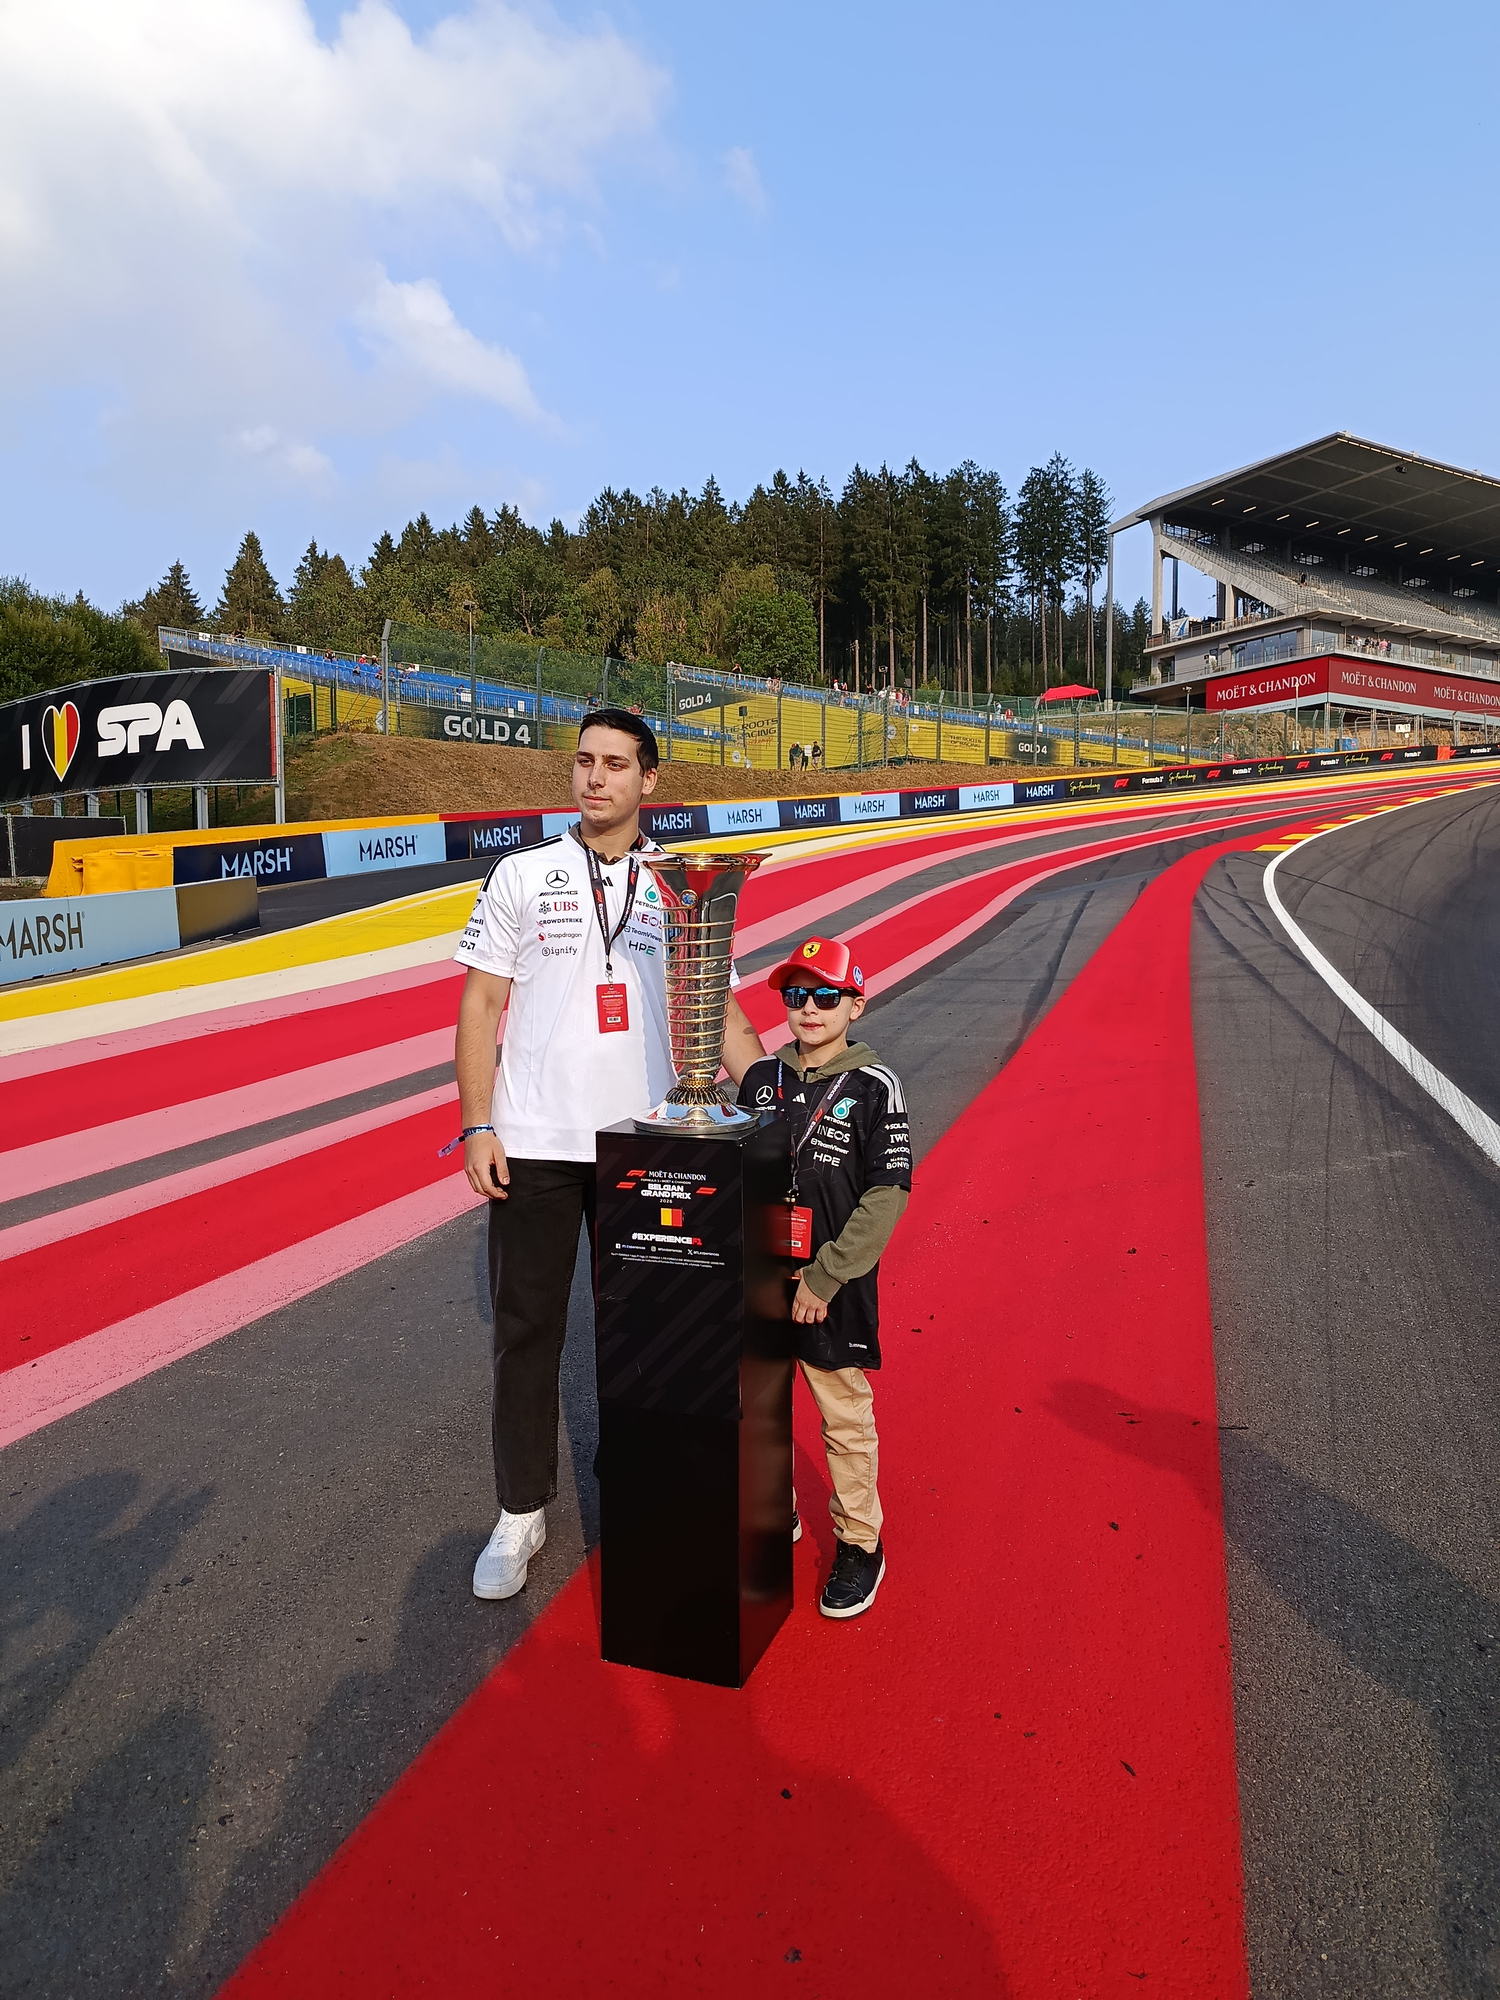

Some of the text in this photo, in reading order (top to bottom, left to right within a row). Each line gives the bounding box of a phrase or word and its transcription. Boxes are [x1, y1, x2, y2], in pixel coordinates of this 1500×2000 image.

[1216, 672, 1317, 702] MOËT & CHANDON
[1341, 671, 1416, 694] MOËT & CHANDON
[678, 692, 711, 711] GOLD 4
[1433, 685, 1456, 700] MOËT
[1457, 690, 1464, 702] &
[21, 699, 205, 770] I SPA
[443, 715, 531, 745] GOLD 4
[1041, 745, 1047, 755] 4
[973, 790, 1000, 803] MARSH
[1026, 785, 1054, 798] MARSH
[854, 800, 885, 814] MARSH
[914, 795, 945, 810] MARSH
[727, 808, 762, 825] MARSH
[794, 803, 825, 819] MARSH
[652, 813, 692, 831] MARSH
[473, 825, 522, 849] MARSH
[359, 835, 416, 862] MARSH
[221, 847, 291, 878] MARSH
[553, 901, 579, 912] UBS
[470, 916, 484, 925] hell
[540, 917, 583, 925] CROWDSTRIKE
[629, 940, 657, 956] HPE
[823, 1114, 851, 1128] PETRONAS
[817, 1124, 851, 1143] INEOS
[890, 1133, 909, 1143] IWC
[817, 1139, 850, 1155] TeamViewer
[813, 1151, 841, 1167] HPE
[648, 1170, 667, 1179] MOËT
[673, 1172, 707, 1181] CHANDON
[640, 1189, 692, 1200] GRAND PRIX
[648, 1183, 684, 1192] BELGIAN
